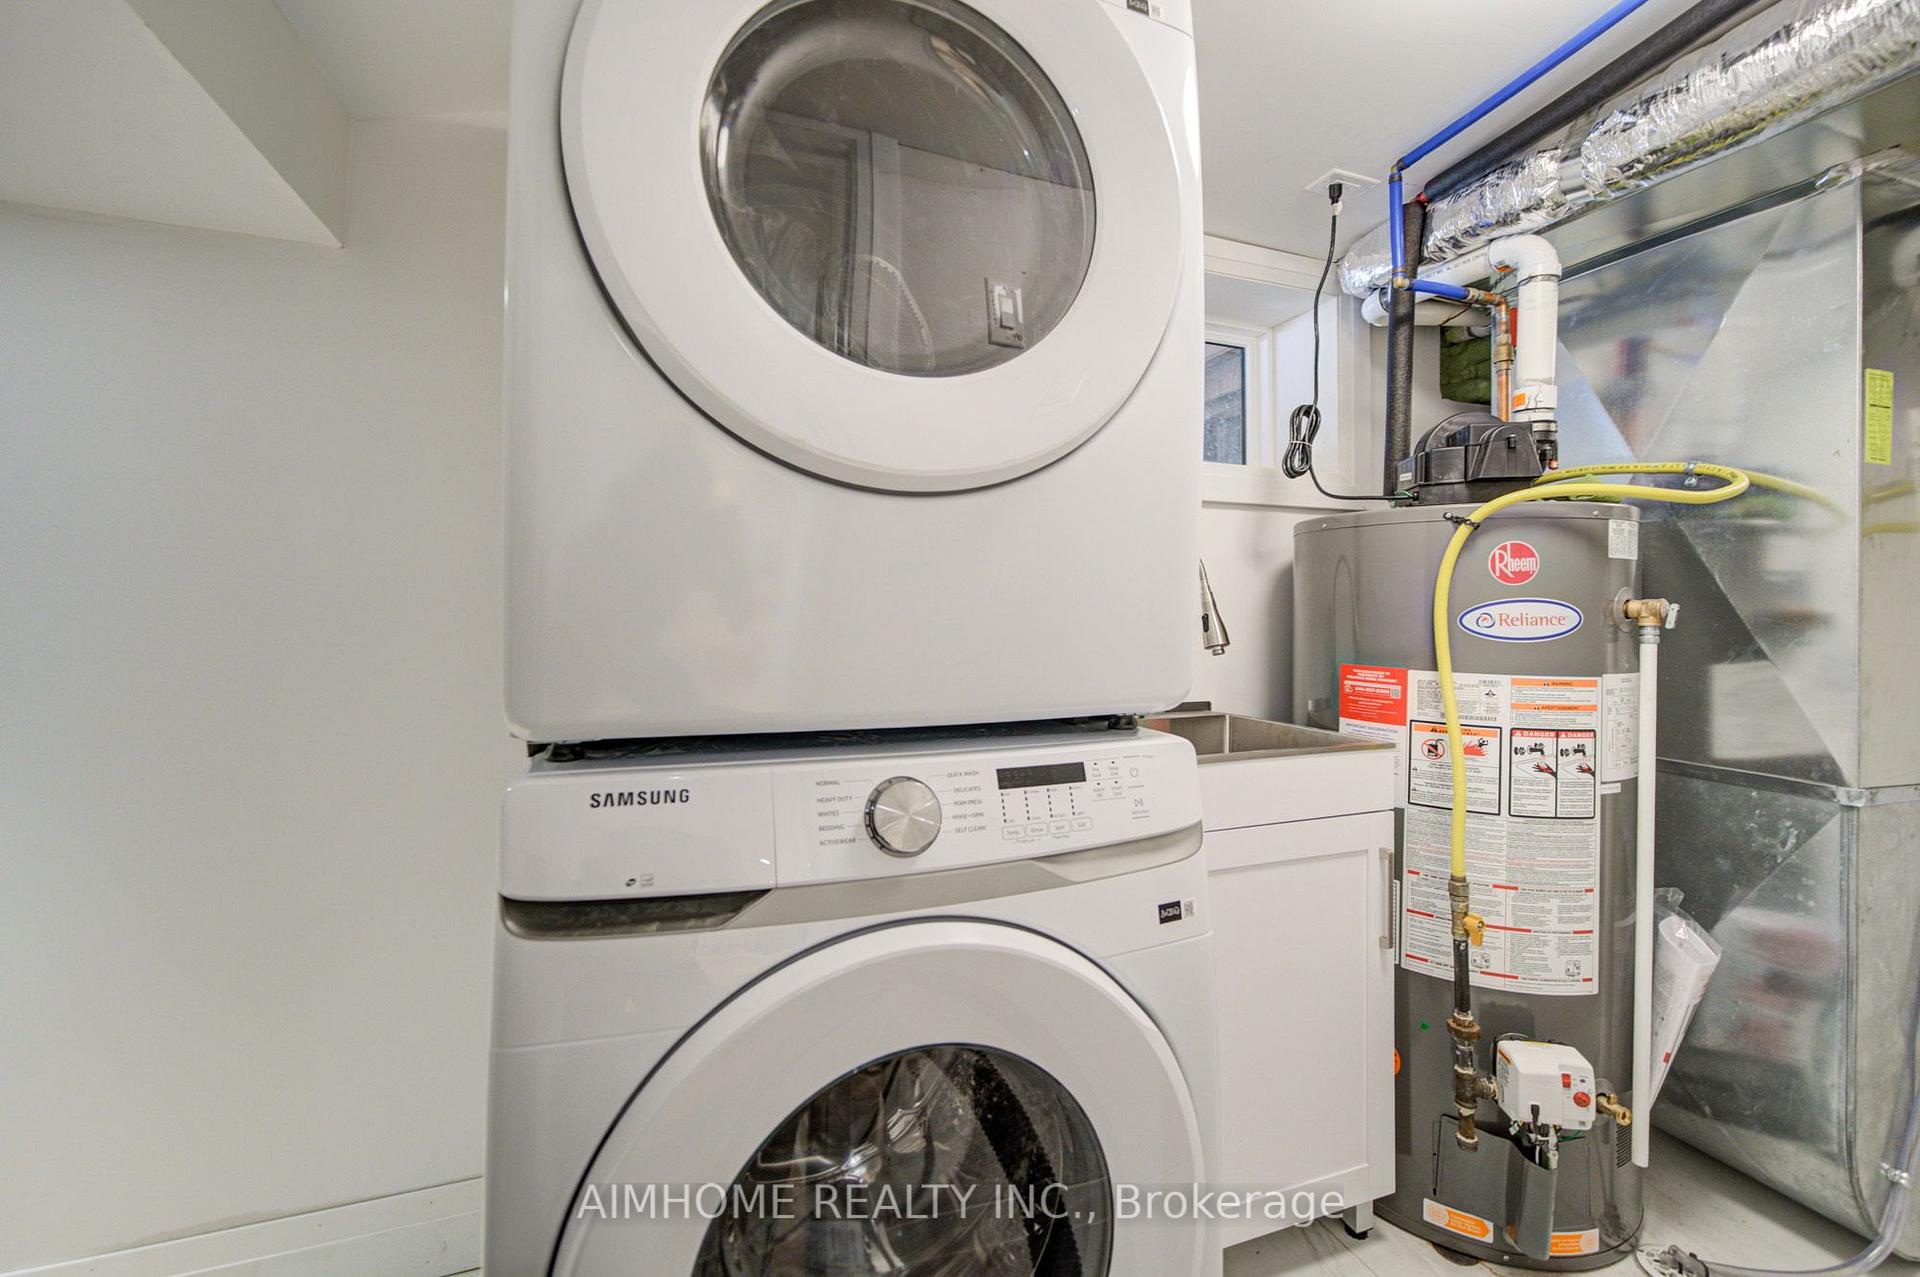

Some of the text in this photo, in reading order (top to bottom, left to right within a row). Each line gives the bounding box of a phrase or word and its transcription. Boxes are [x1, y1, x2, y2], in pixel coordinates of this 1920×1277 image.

[1495, 543, 1537, 578] Rheem
[1498, 612, 1567, 628] Reliance
[815, 779, 841, 787] NORMAL
[590, 789, 690, 809] SAMSUNG
[837, 795, 852, 803] DUTY
[817, 809, 840, 818] WHITES
[818, 823, 846, 832] BEDDING
[819, 836, 857, 847] ACTIVEWEAR
